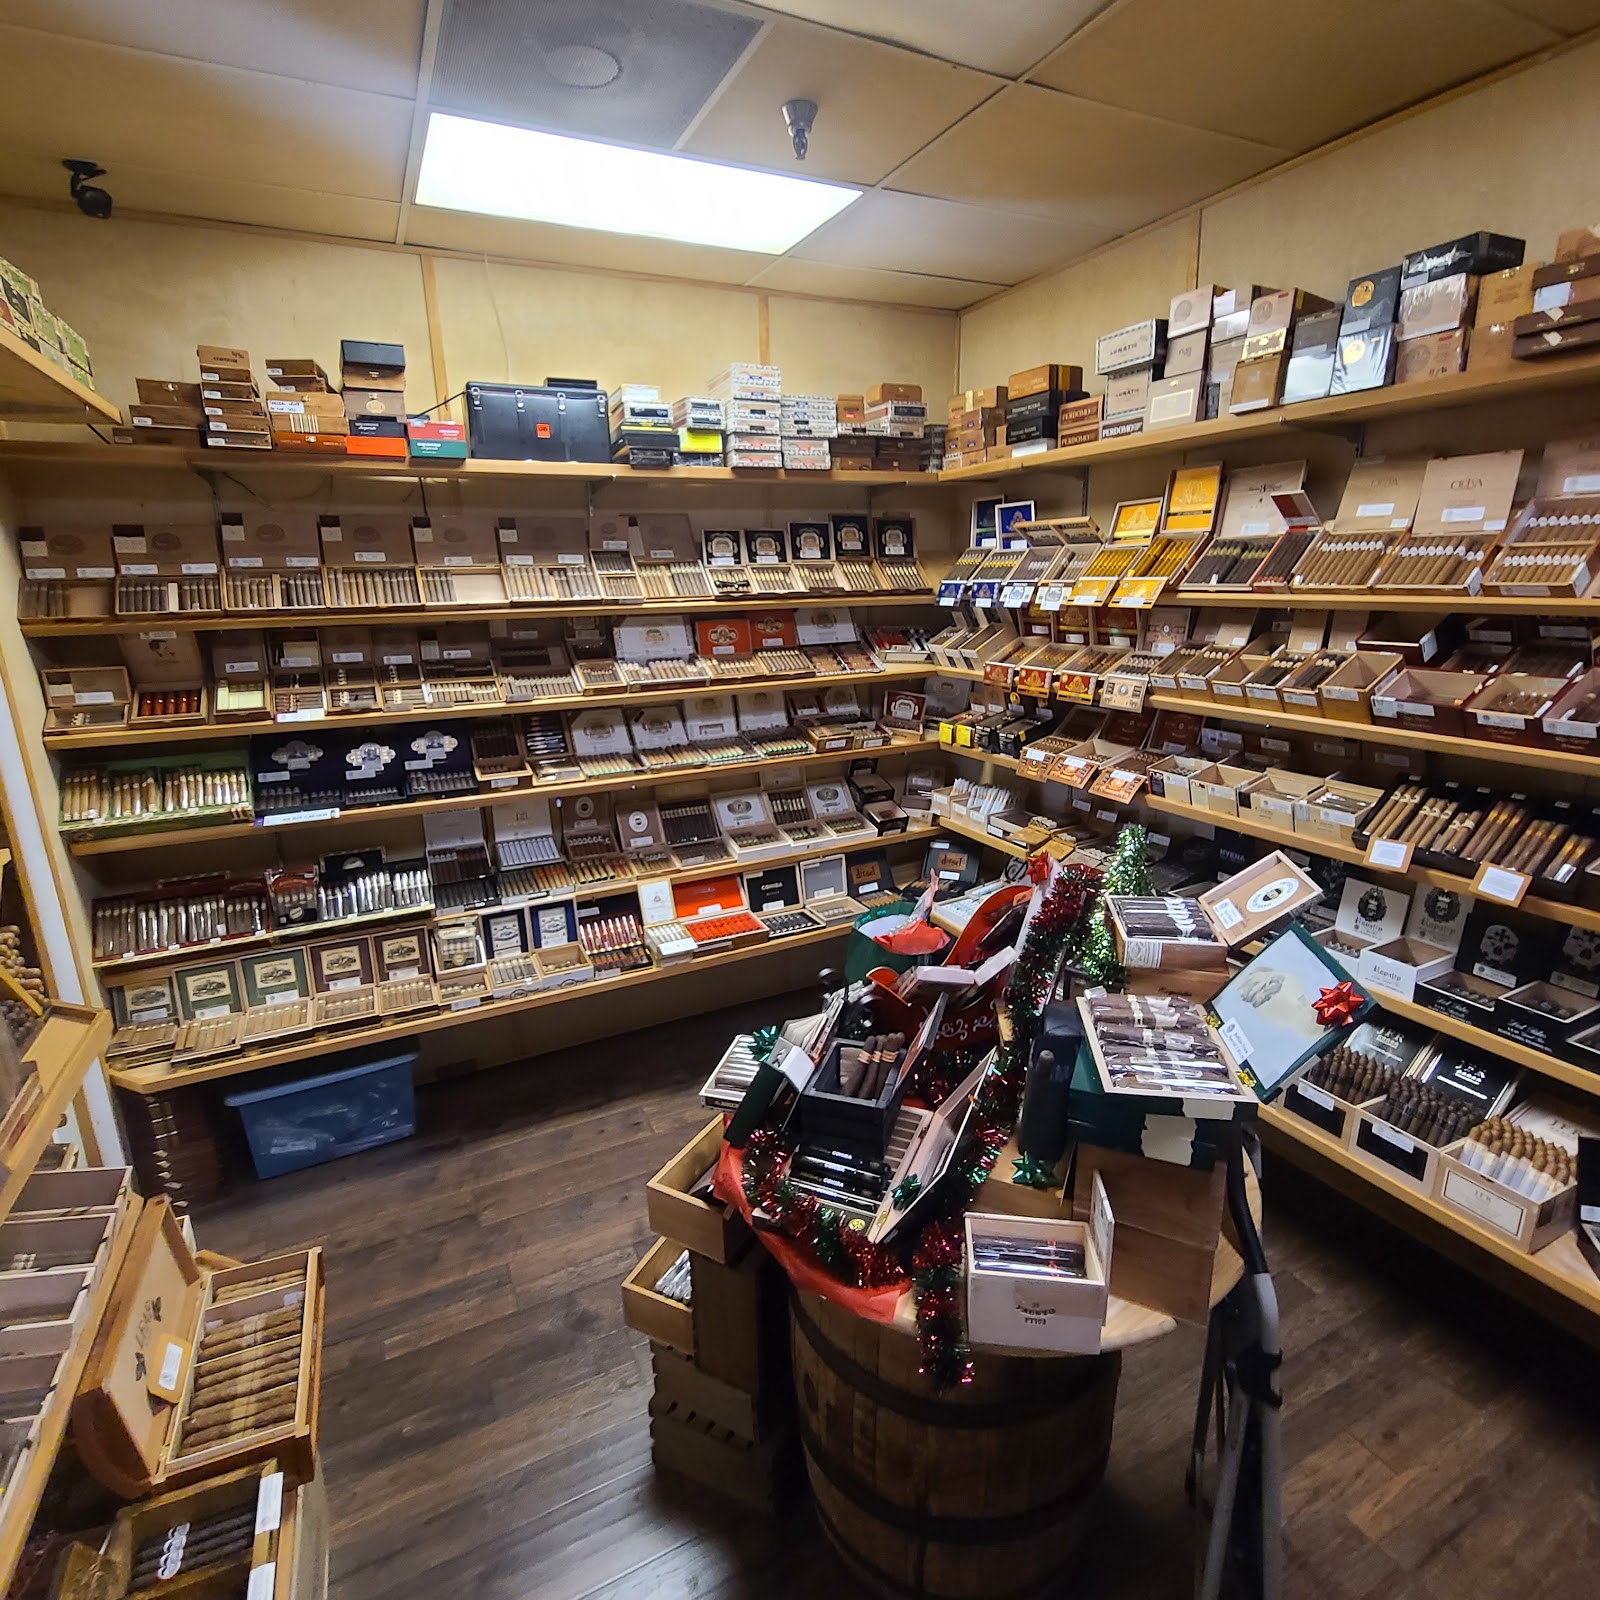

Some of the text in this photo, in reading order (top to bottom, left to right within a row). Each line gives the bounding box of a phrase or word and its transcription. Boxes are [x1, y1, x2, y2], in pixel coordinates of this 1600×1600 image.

[1062, 407, 1091, 421] PERDOMO
[1102, 424, 1134, 438] PERDOMO
[1061, 434, 1090, 447] PERDOMO
